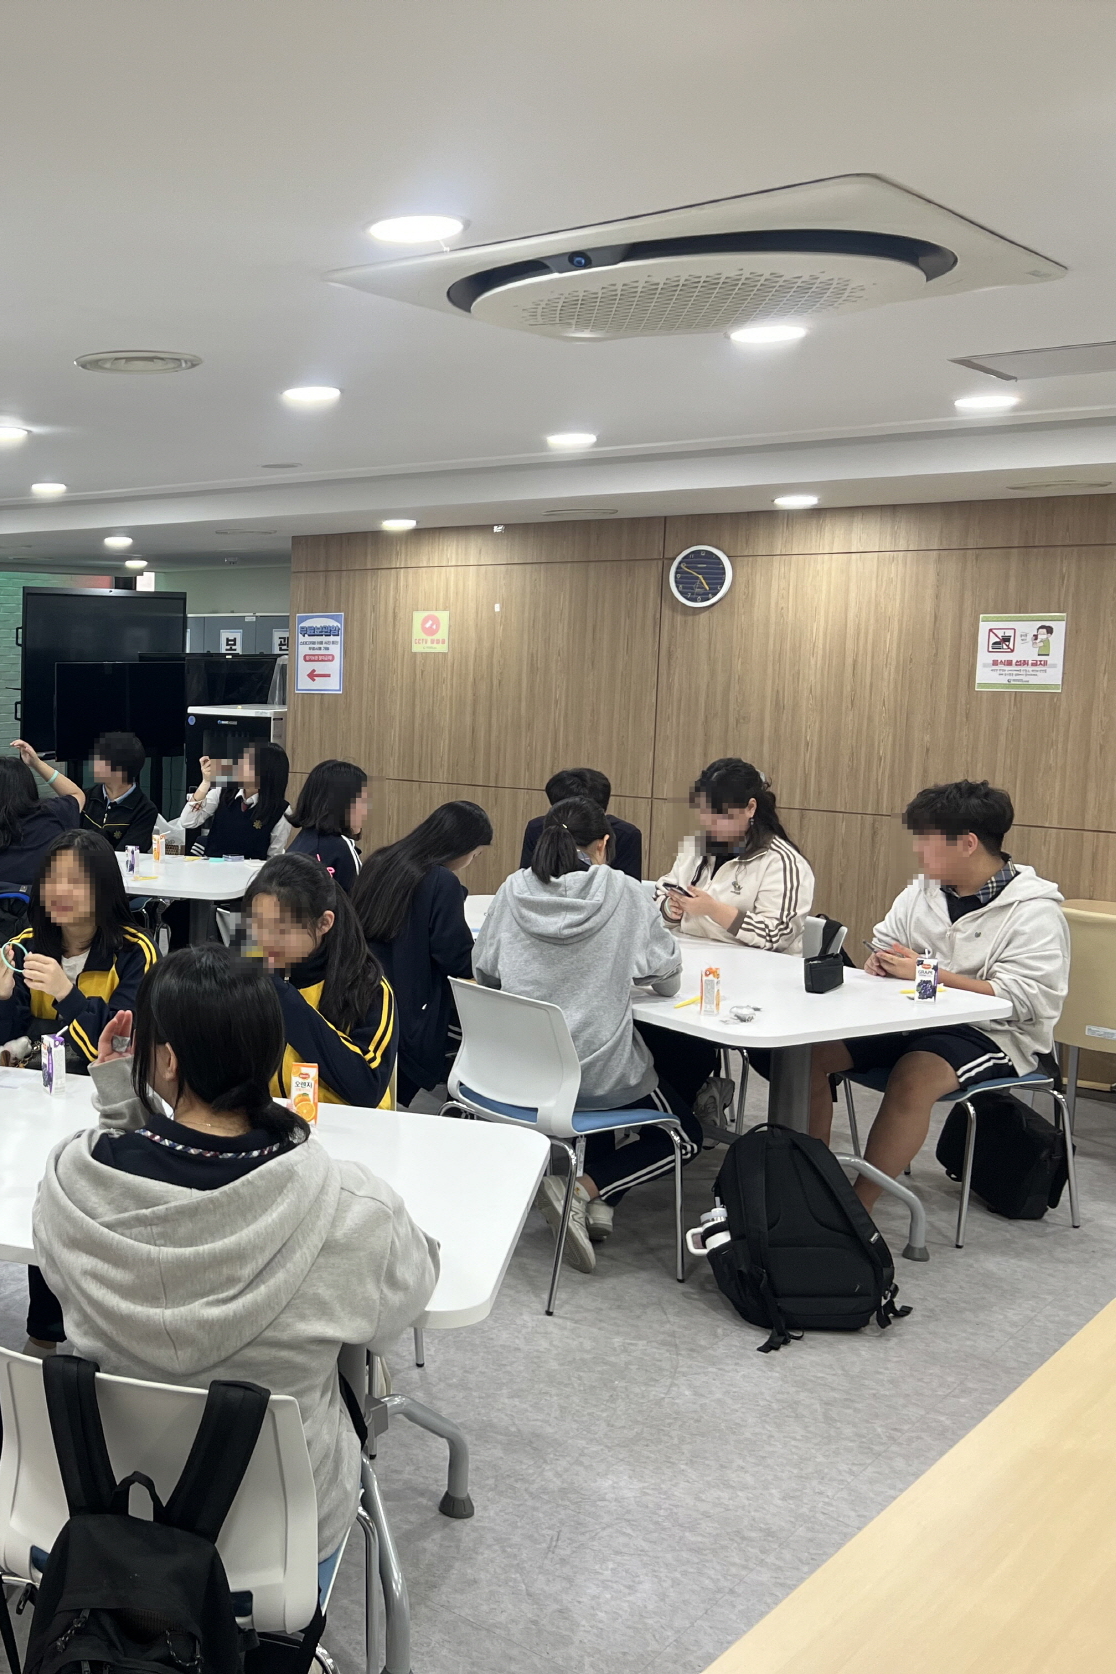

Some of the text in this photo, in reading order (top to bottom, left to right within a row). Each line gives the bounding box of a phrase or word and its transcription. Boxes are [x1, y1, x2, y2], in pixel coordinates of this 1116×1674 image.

[224, 637, 237, 652] 보
[1014, 659, 1030, 667] 섭취
[294, 1080, 313, 1089] 오렌지
